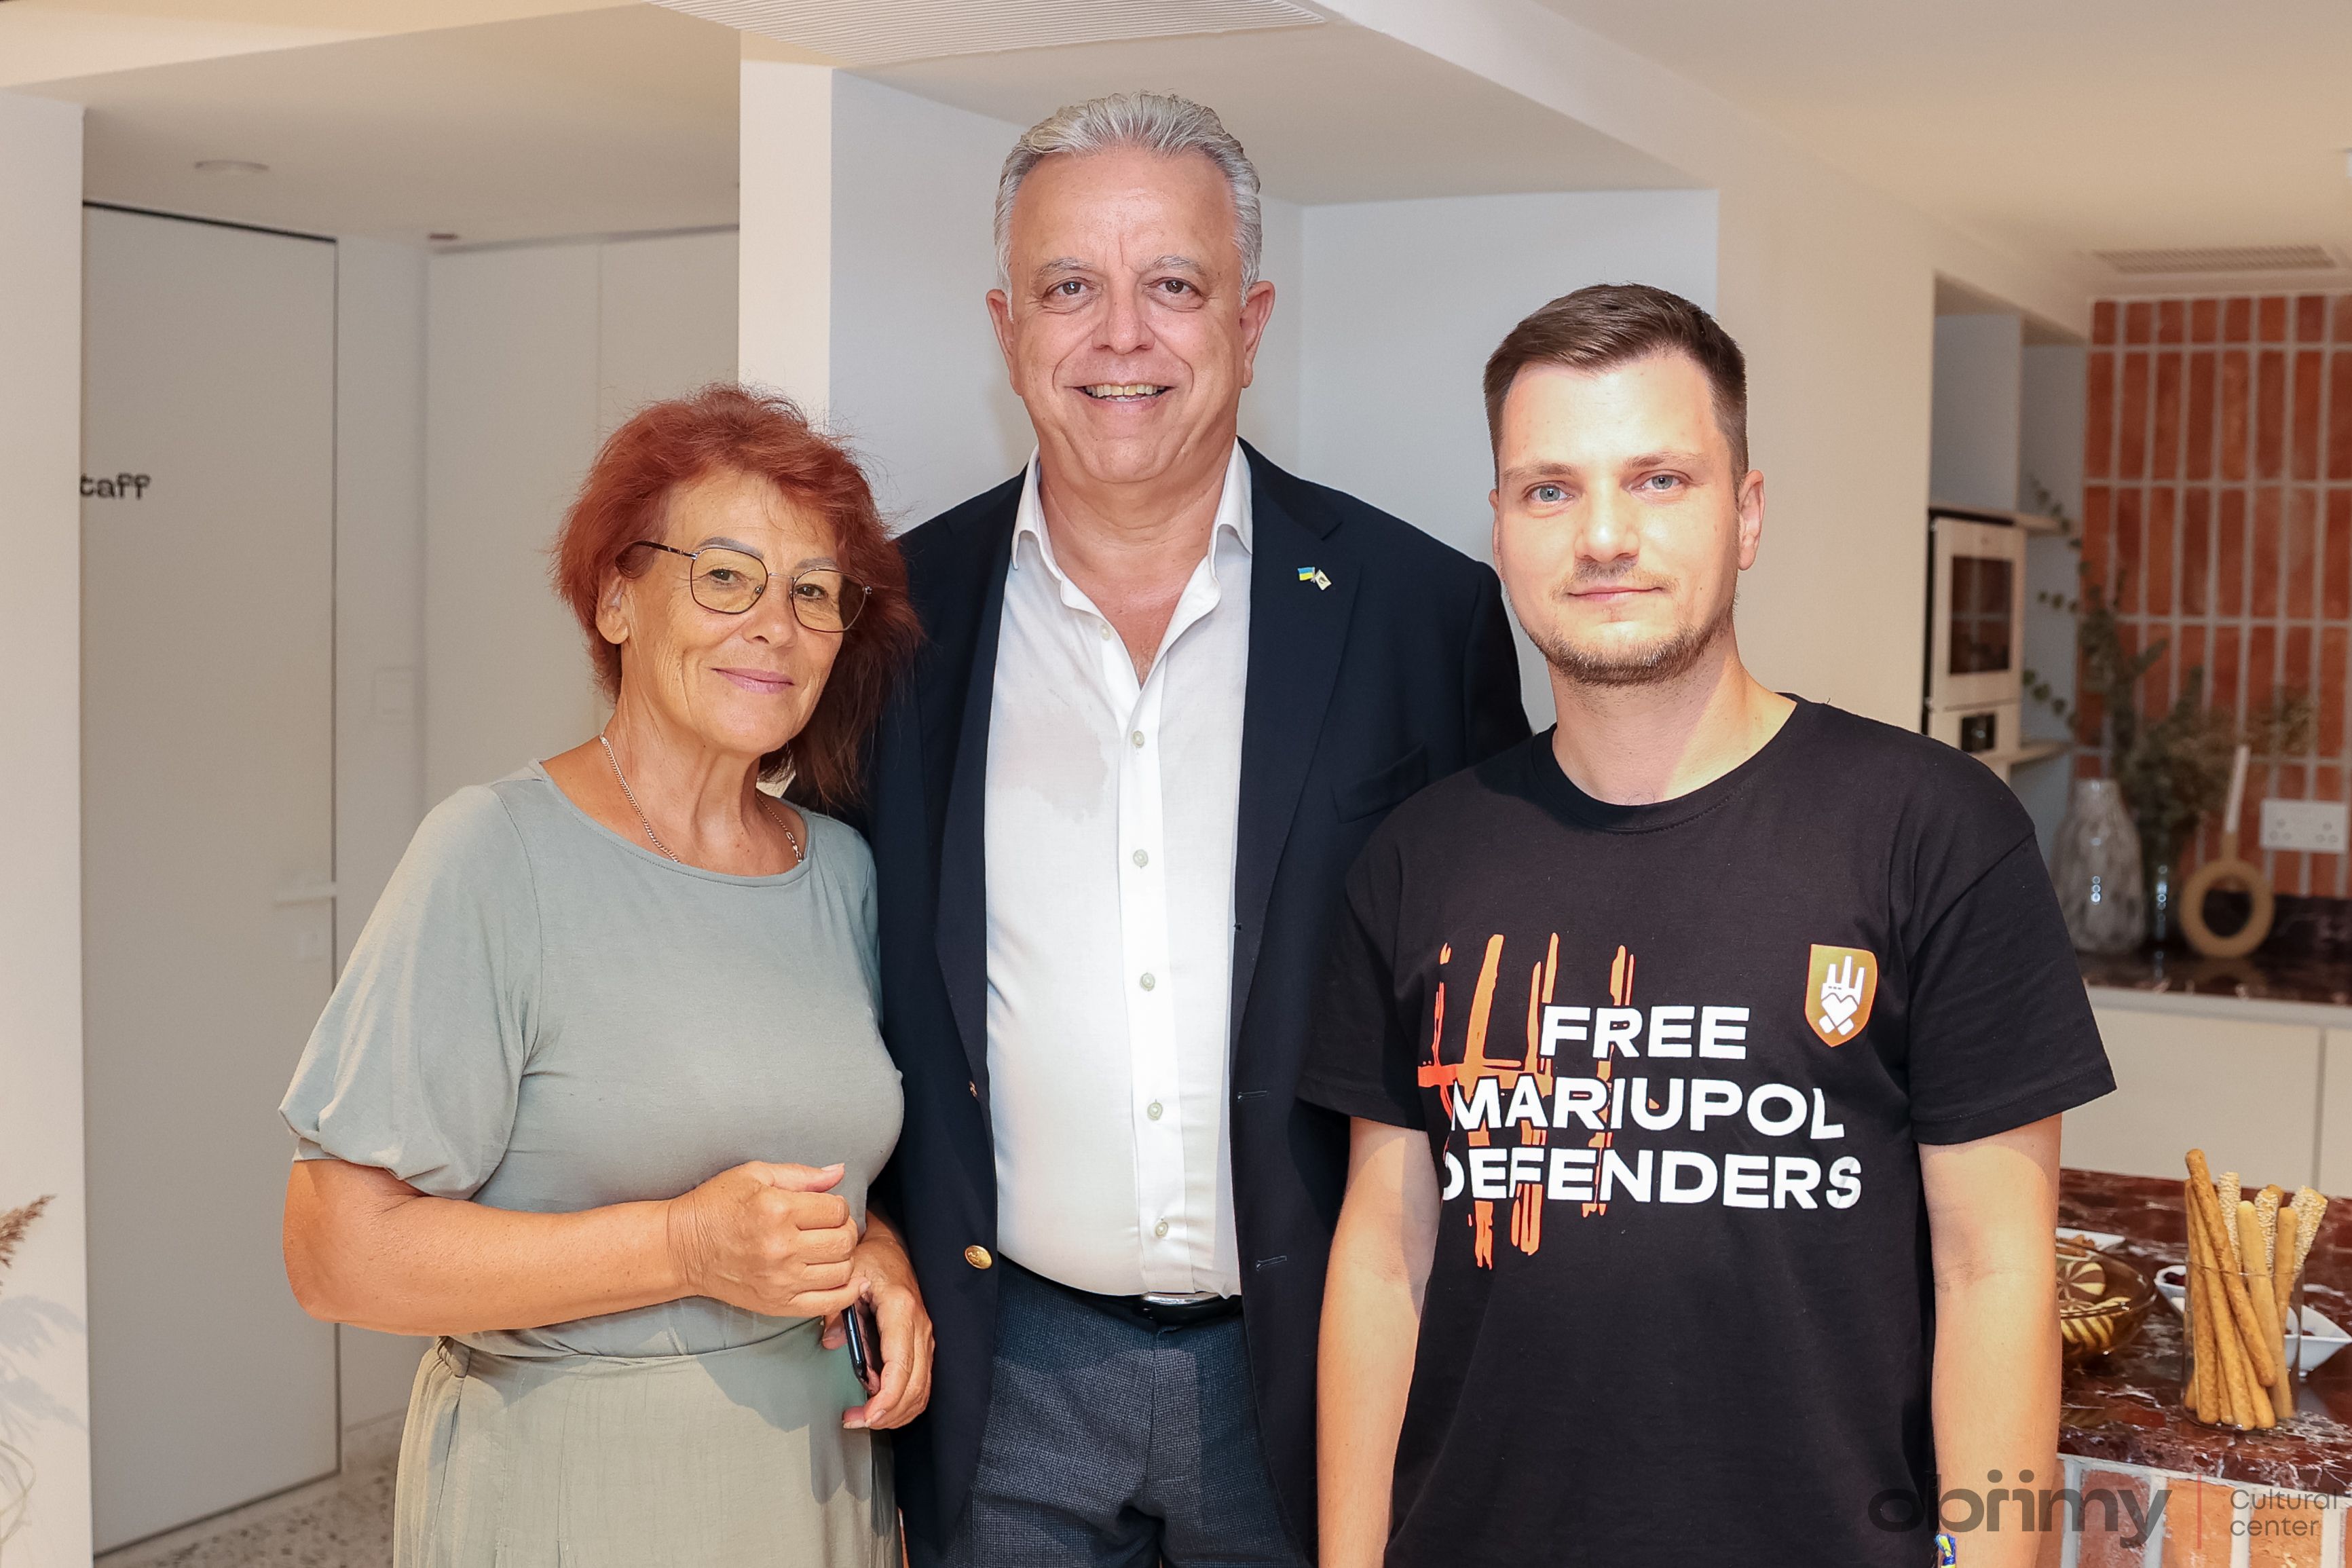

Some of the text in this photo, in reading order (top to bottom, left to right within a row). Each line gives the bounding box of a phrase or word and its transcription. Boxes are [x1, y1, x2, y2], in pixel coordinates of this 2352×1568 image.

[80, 472, 151, 499] taff
[1540, 1006, 1750, 1060] FREE
[1451, 1075, 1846, 1139] MARIUPOL
[1442, 1147, 1862, 1209] DEFENDERS
